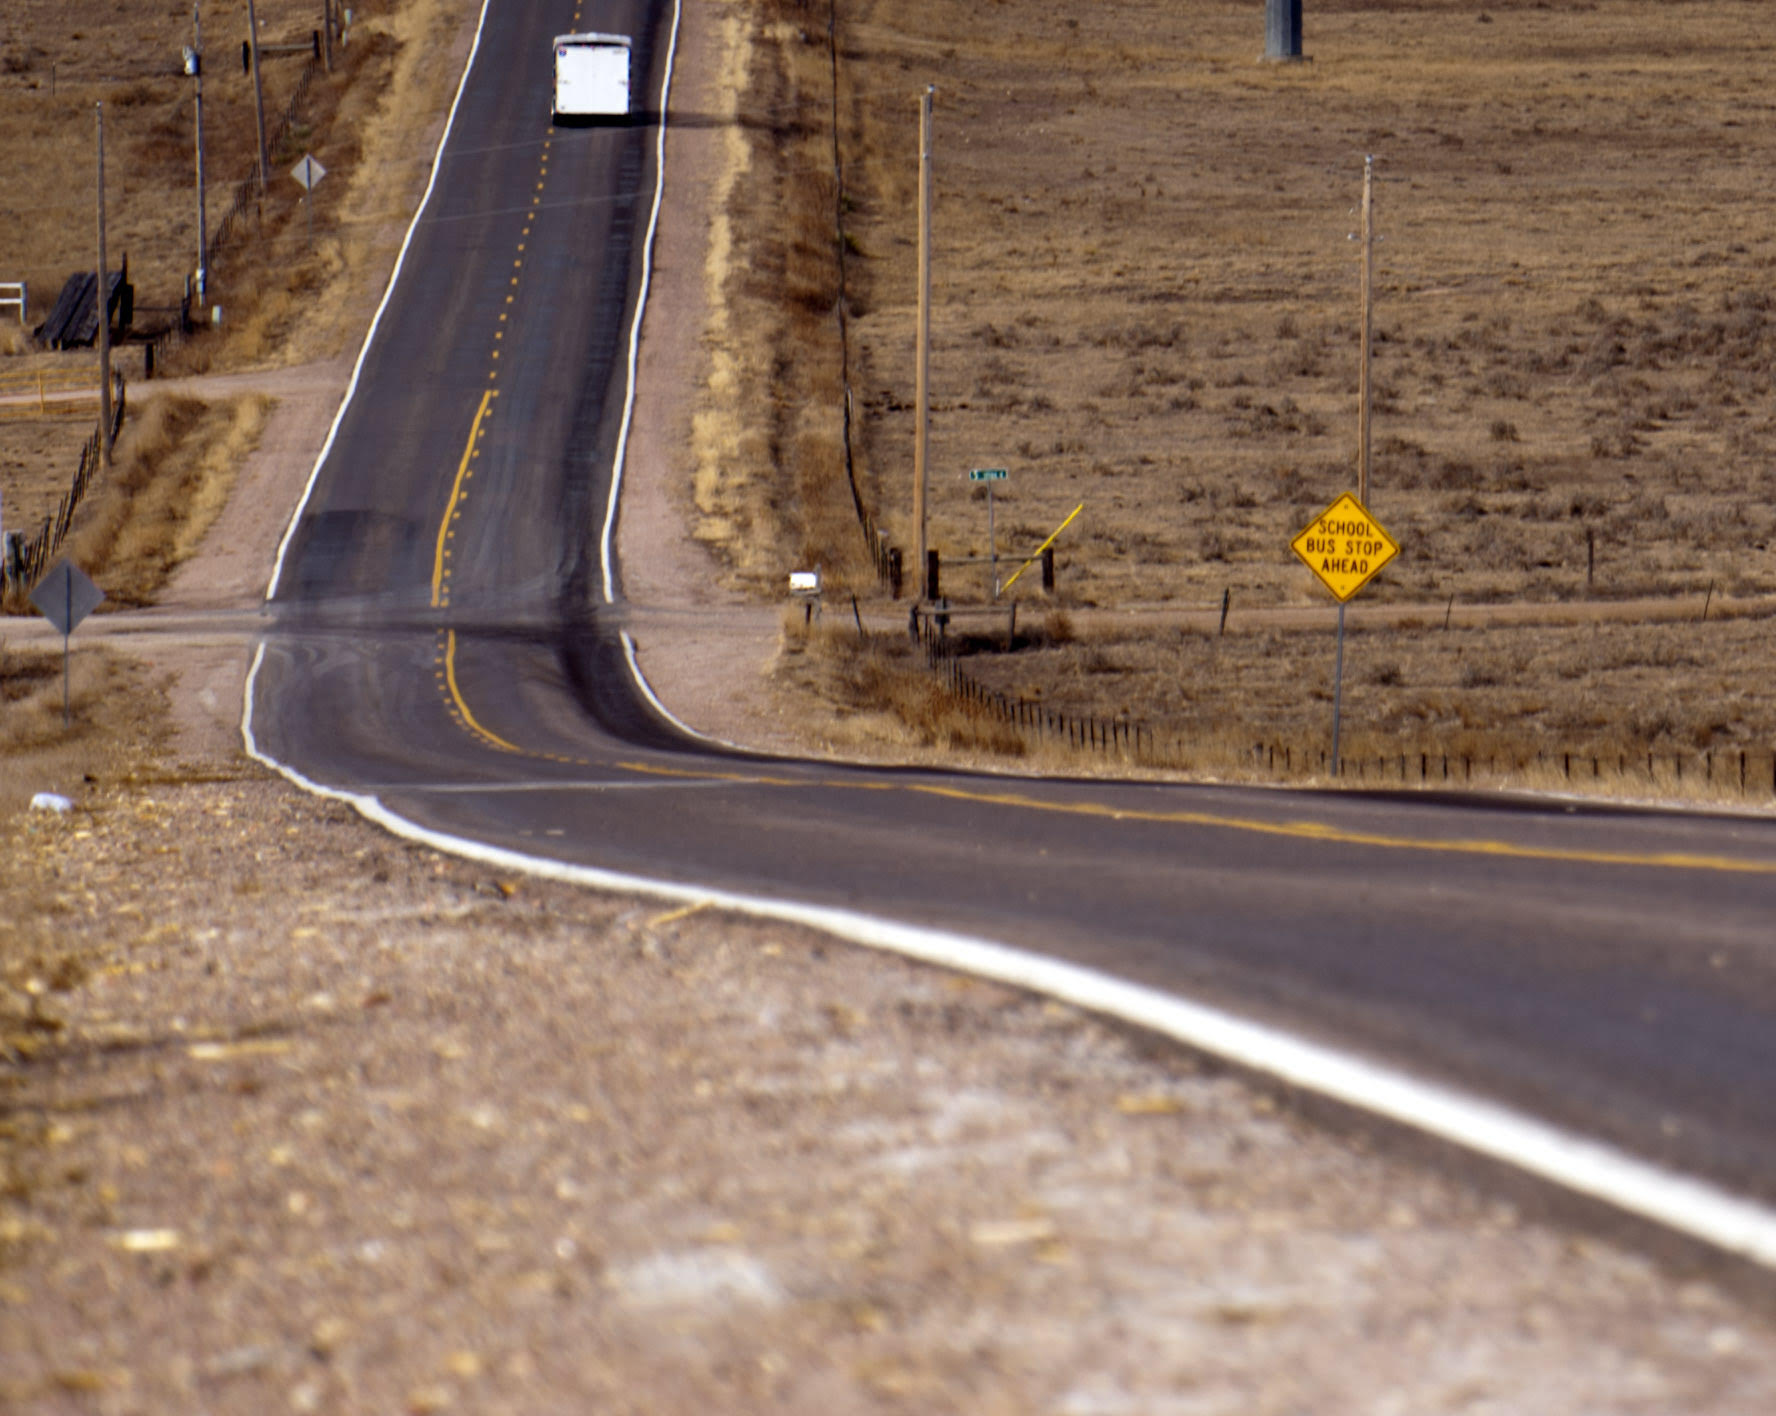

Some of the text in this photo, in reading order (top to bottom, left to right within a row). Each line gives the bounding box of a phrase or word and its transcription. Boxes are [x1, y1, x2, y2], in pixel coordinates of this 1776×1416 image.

[1318, 520, 1373, 537] SCHOOL
[1306, 538, 1383, 556] BUS STOP
[1321, 558, 1368, 574] AHEAD
